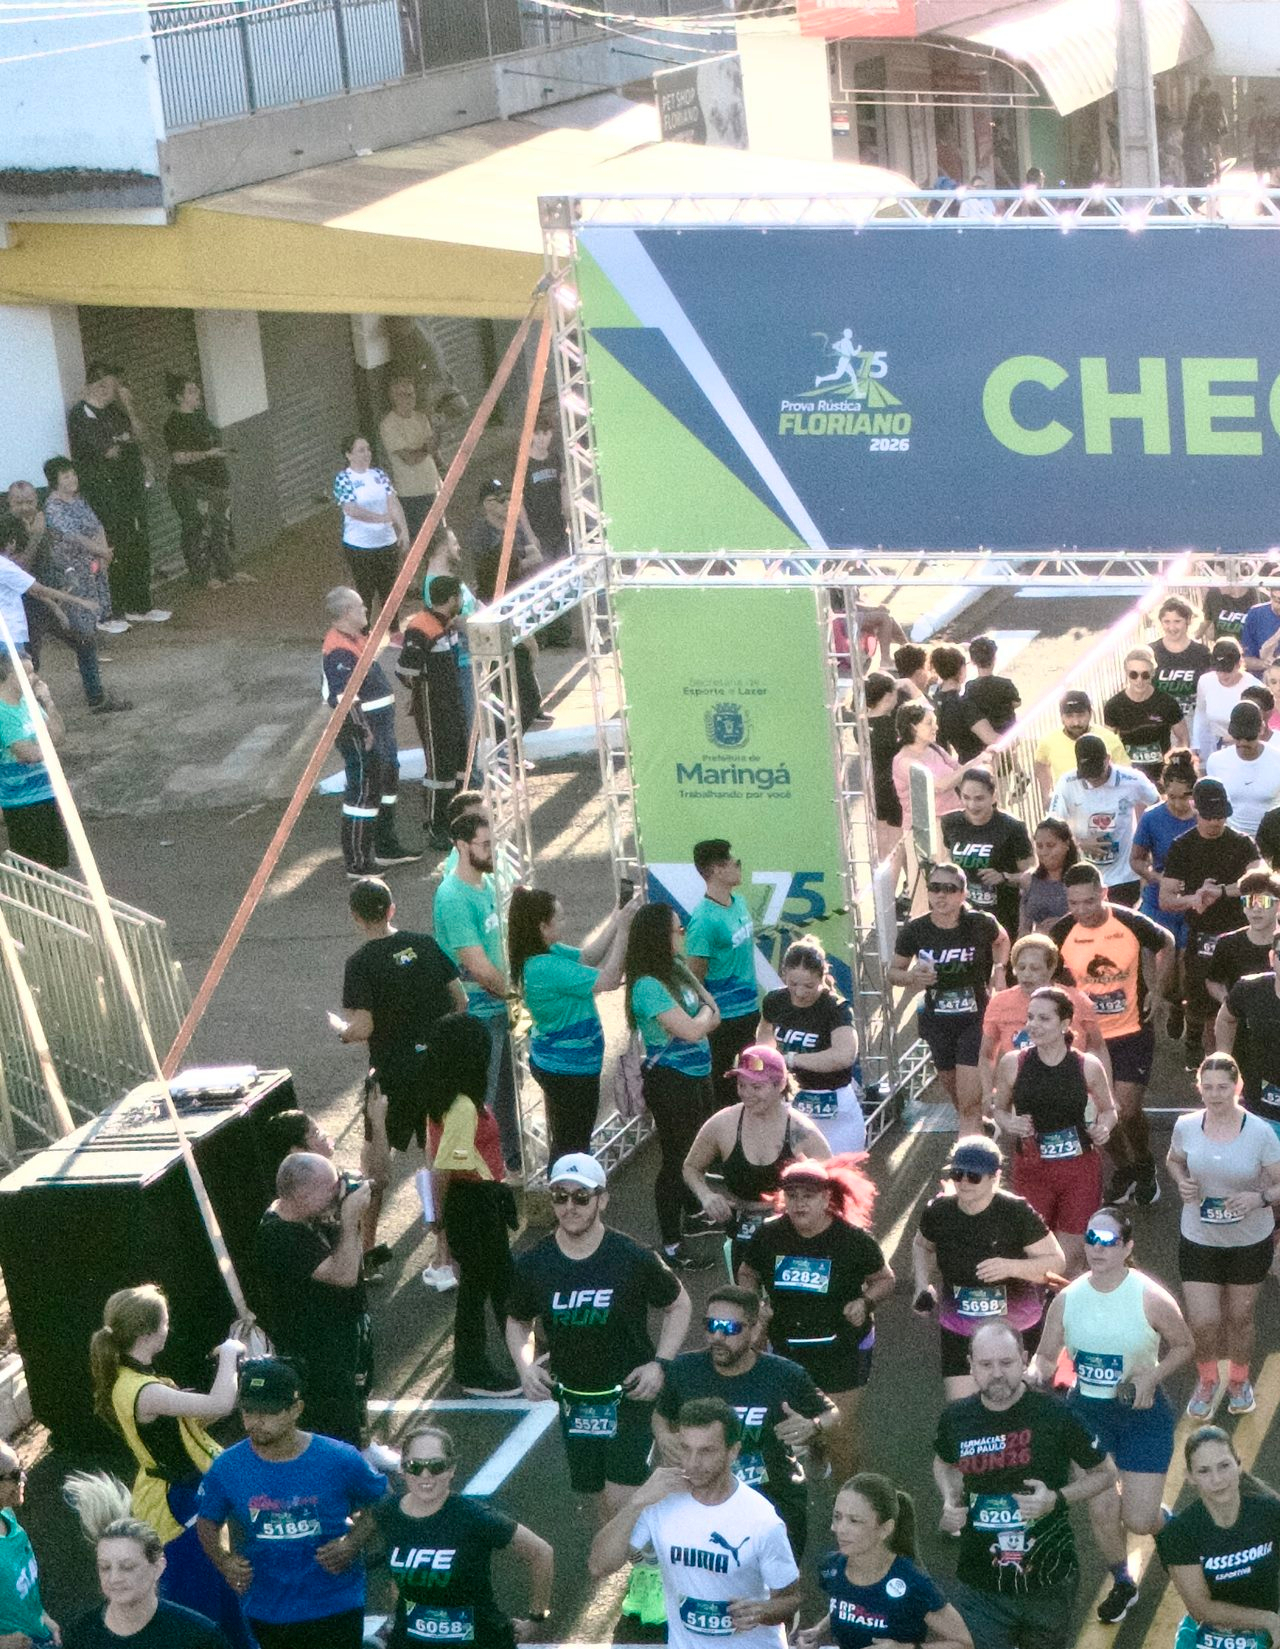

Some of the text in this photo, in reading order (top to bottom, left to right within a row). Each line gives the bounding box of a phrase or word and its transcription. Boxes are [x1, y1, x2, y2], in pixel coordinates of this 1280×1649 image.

[781, 399, 861, 412] Prova Rústica
[778, 413, 911, 436] FLORIANO
[869, 438, 910, 452] 2026
[1158, 669, 1195, 682] LIFE
[683, 686, 725, 697] Esporte
[738, 687, 767, 696] Lazer
[676, 762, 791, 791] Maringá
[679, 790, 743, 799] Trabalhando
[952, 842, 993, 857] LIFE
[752, 871, 827, 926] 75
[774, 1026, 819, 1048] LIFE
[782, 1269, 821, 1284] 6282
[552, 1289, 614, 1310] LIFE
[962, 1299, 999, 1313] 5698
[552, 1306, 609, 1326] RUN
[1078, 1365, 1115, 1380] 5700
[574, 1417, 609, 1431] 5527
[977, 1441, 1006, 1453] PAULO
[980, 1510, 1022, 1523] 6204
[390, 1547, 457, 1569] LIFE
[670, 1545, 729, 1574] PUMA
[1204, 1541, 1274, 1570] ASSESSORIA
[687, 1613, 733, 1629] 5196
[1204, 1633, 1248, 1649] 5769
